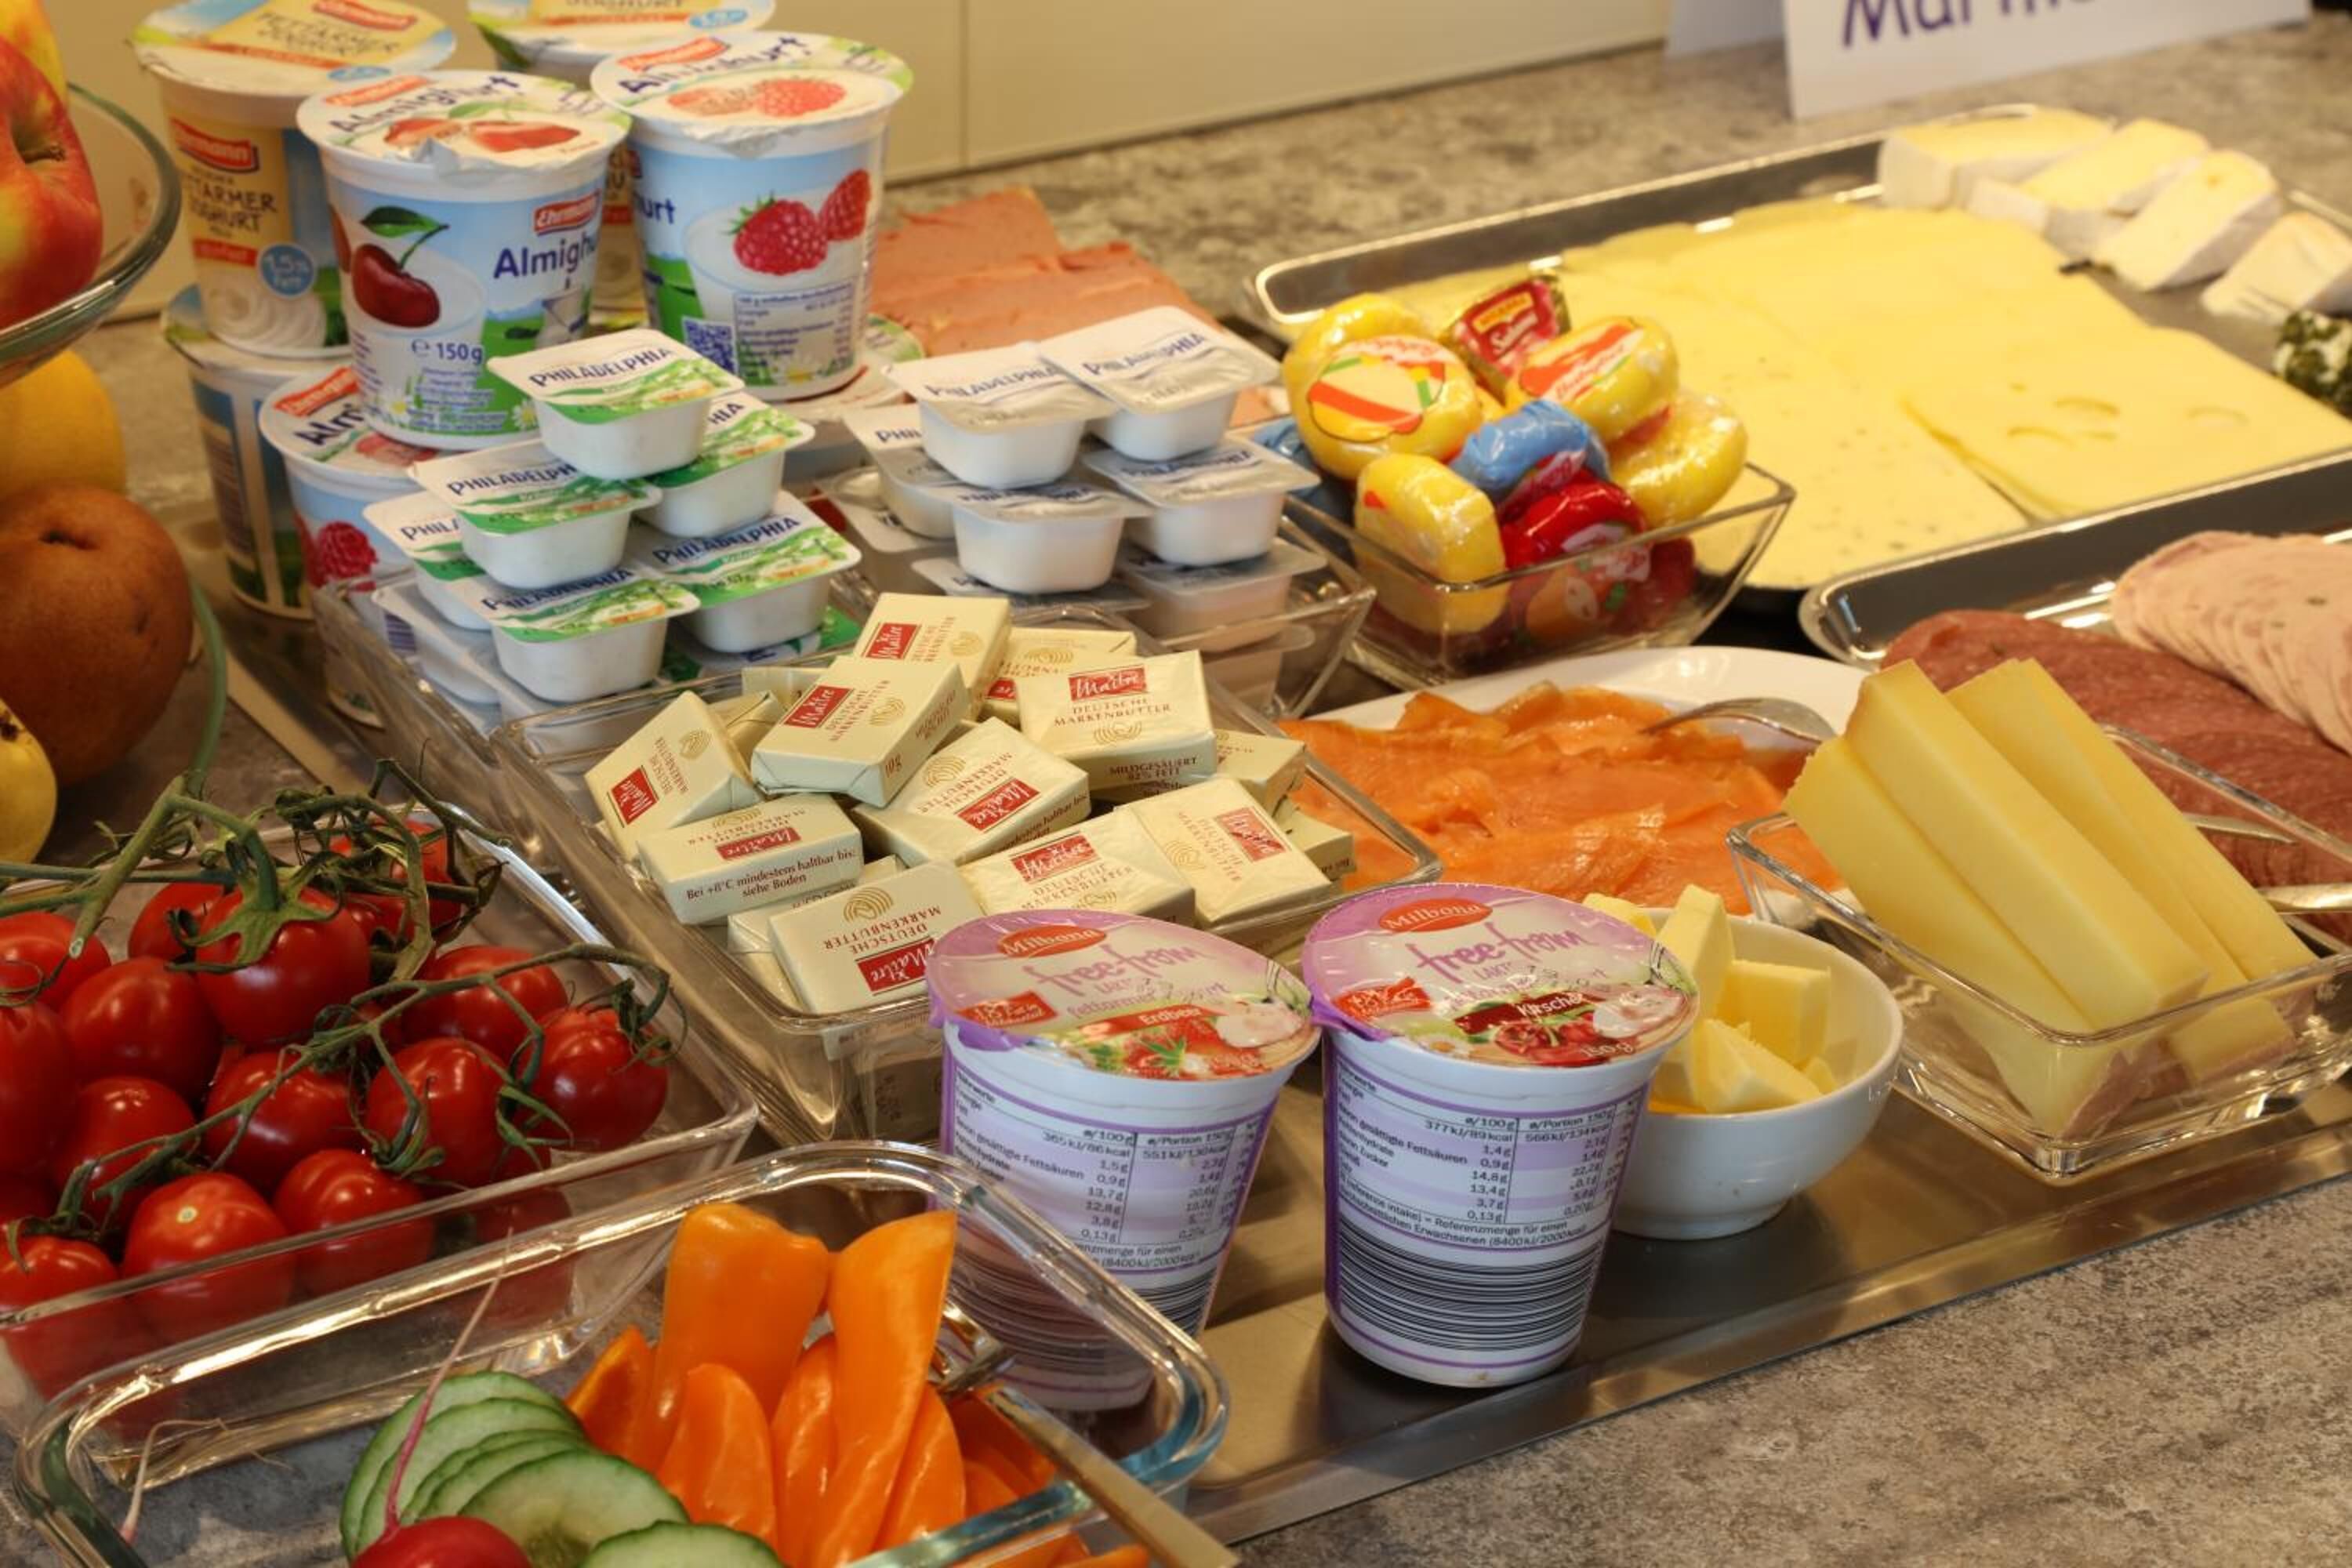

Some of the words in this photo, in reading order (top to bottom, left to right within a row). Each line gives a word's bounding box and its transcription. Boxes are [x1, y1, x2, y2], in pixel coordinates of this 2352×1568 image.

[528, 346, 673, 388] PHILADELPHIA
[447, 461, 579, 496] PHILADELPH
[652, 516, 801, 565] PHILADELPHIA
[1054, 703, 1172, 728] MARKENBUTTER
[735, 862, 797, 886] mindestens
[771, 872, 808, 891] Boden
[823, 905, 942, 950] MARKENBUTTER
[1386, 902, 1480, 929] Milbona
[851, 922, 928, 955] DEUTSCHE
[1003, 927, 1099, 956] Milbona
[1406, 1141, 1468, 1166] Fettsäuren
[1414, 1223, 1486, 1245] Erwachsenen
[1434, 1215, 1522, 1236] Referenzmenge
[1523, 1221, 1538, 1235] für
